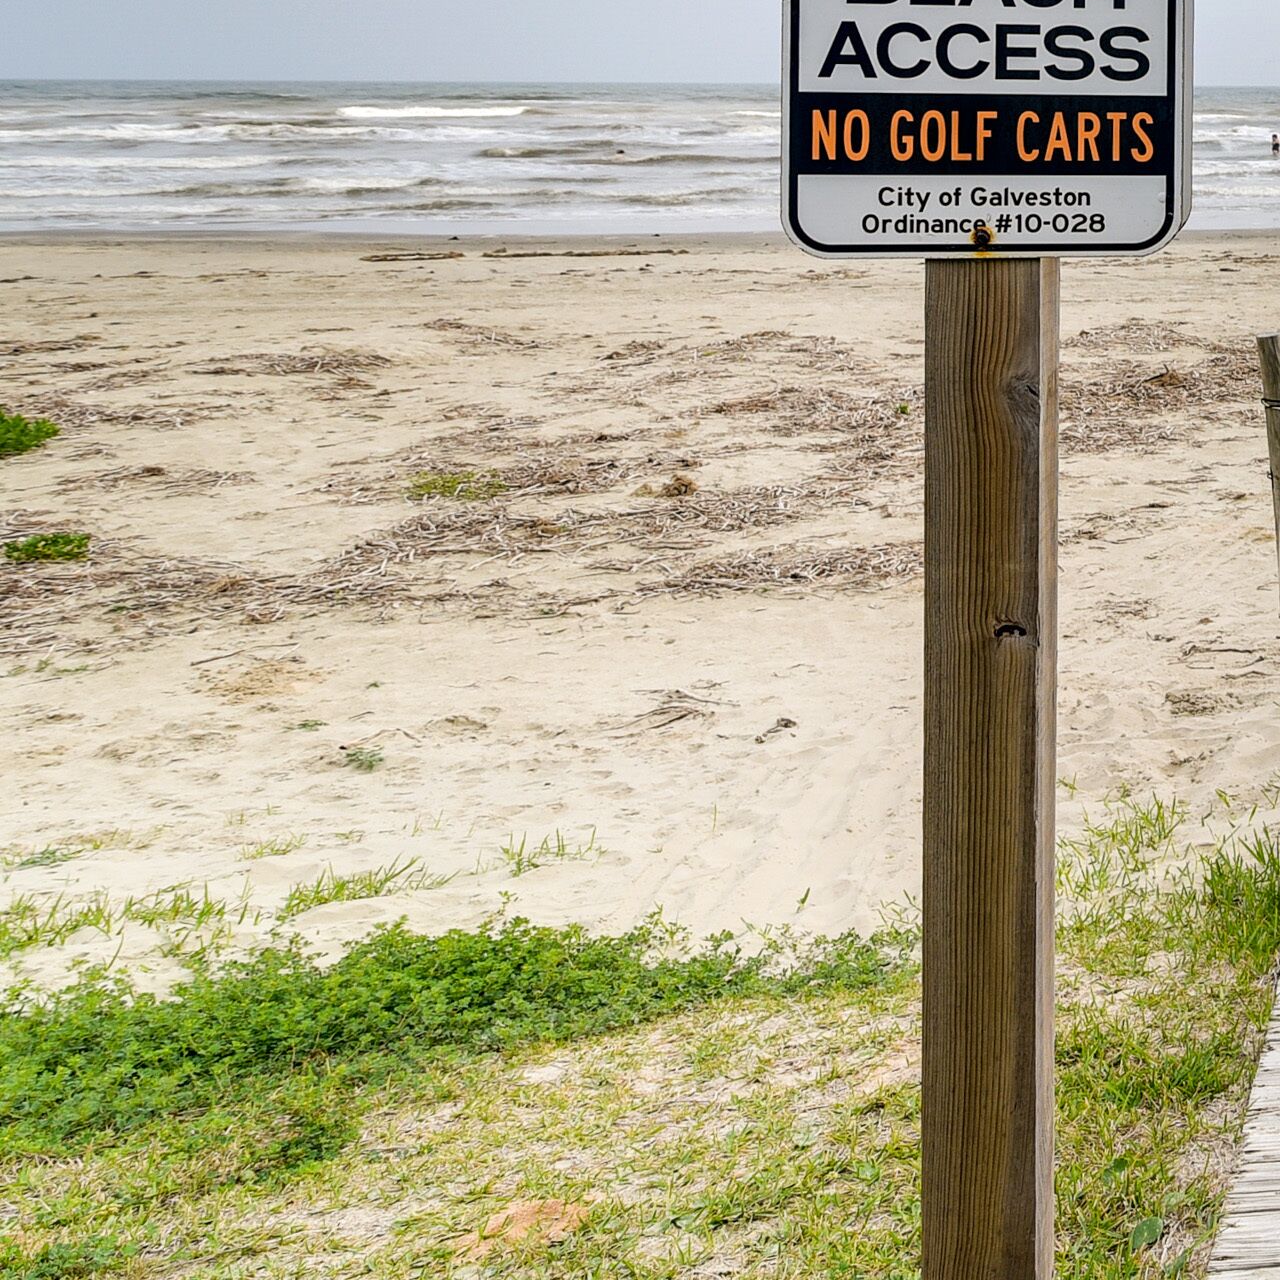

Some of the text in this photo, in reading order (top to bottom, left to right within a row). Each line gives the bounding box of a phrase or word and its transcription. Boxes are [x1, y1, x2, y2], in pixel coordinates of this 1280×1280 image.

[817, 20, 1151, 81] ACCESS
[811, 108, 1154, 162] NO GOLF CARTS
[878, 186, 1092, 212] City of Galveston
[861, 213, 1106, 234] Ordinance #10-028
